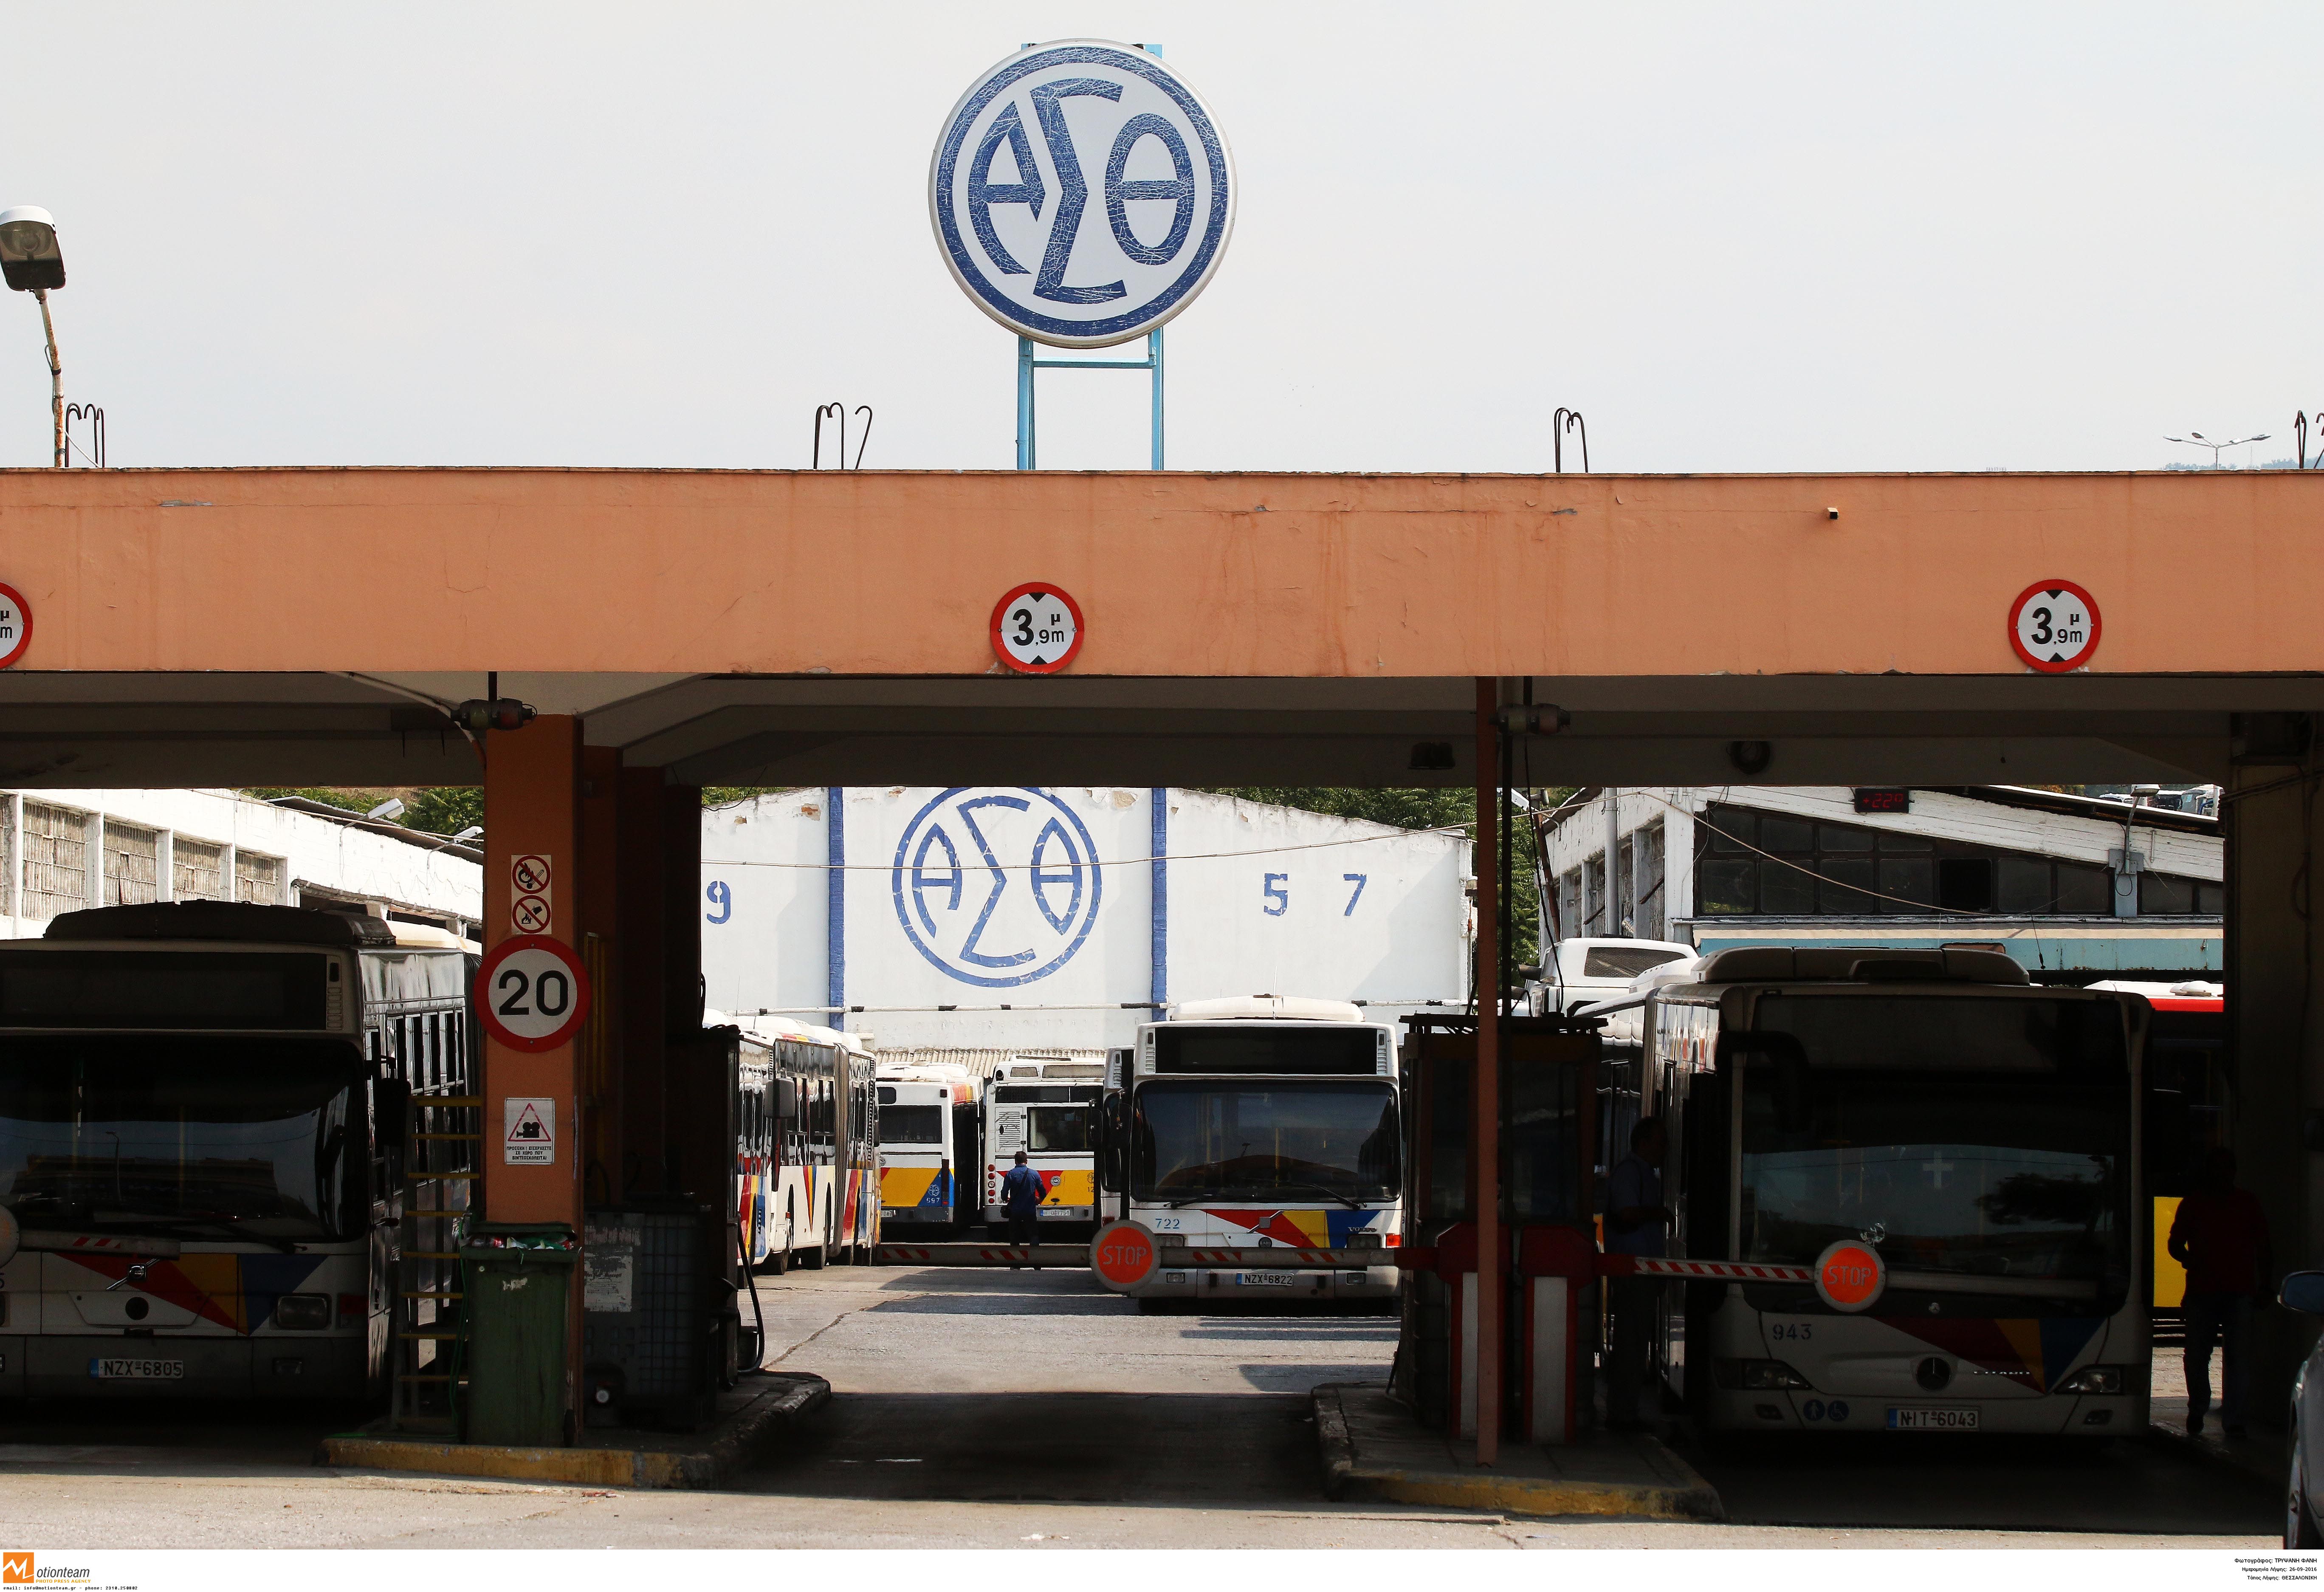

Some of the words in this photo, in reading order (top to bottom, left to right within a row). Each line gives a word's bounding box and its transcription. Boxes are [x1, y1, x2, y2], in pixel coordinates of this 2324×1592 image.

[706, 880, 731, 924] 9
[1264, 873, 1288, 917] 5
[1343, 873, 1367, 917] 7
[498, 968, 569, 1016] 20
[1155, 1218, 1180, 1229] 722
[1103, 1245, 1147, 1266] STOP
[1827, 1265, 1874, 1287] STOP
[1772, 1324, 1812, 1341] 943
